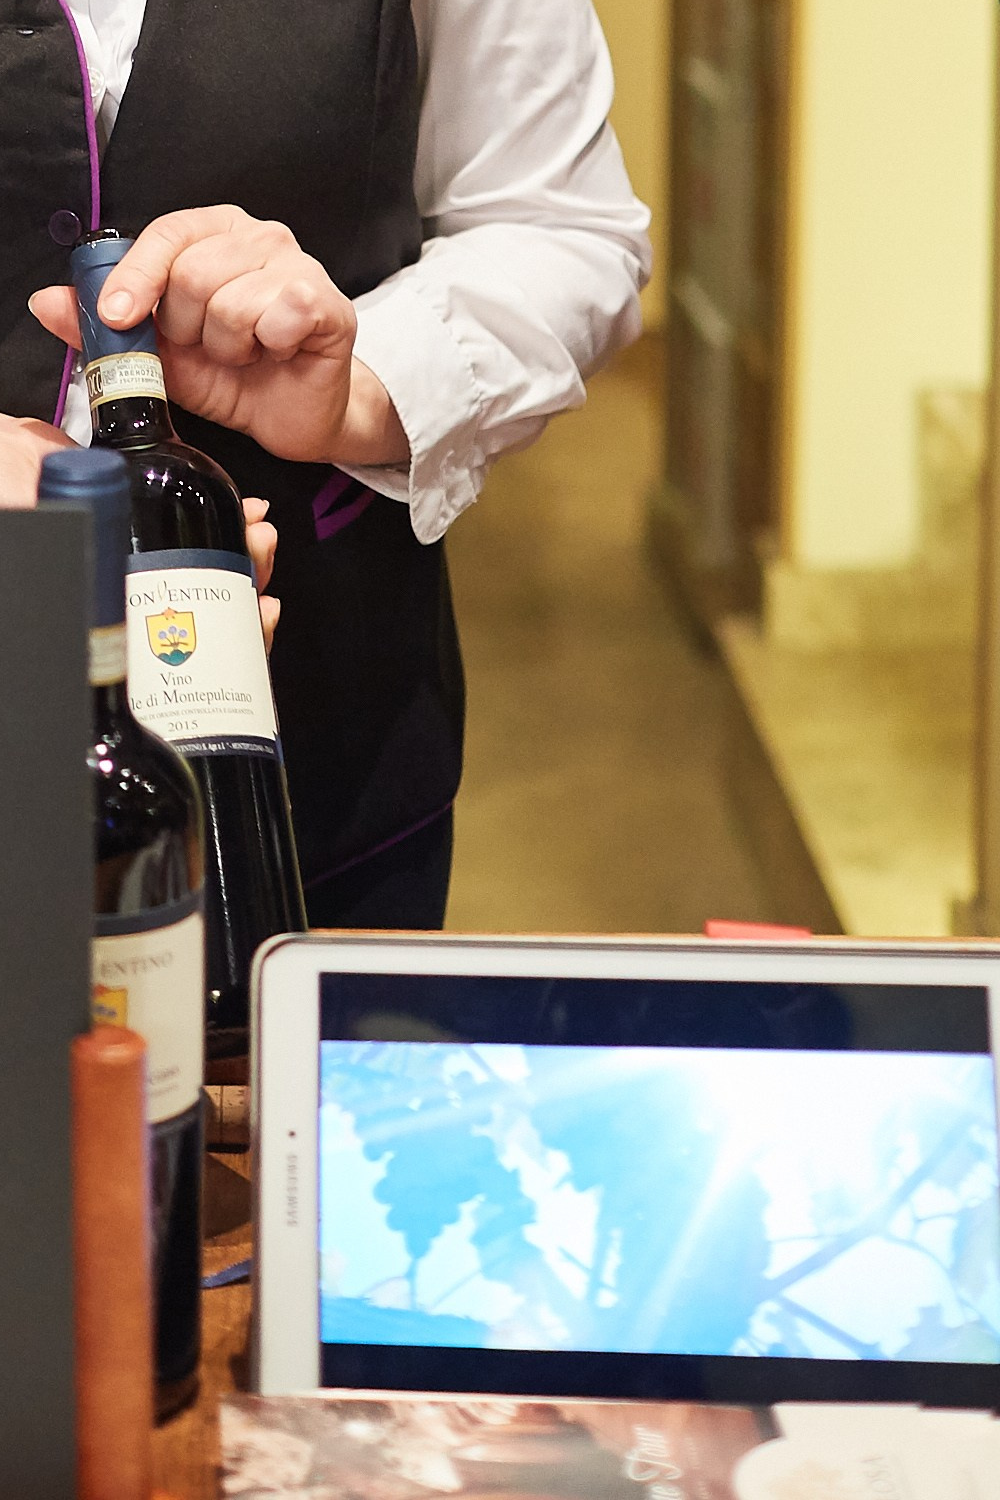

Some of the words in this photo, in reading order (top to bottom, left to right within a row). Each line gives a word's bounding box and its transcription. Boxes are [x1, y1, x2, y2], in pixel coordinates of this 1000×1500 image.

[129, 580, 231, 607] ONVENTINO
[160, 672, 193, 687] Vino
[131, 697, 142, 711] le
[146, 693, 159, 708] di
[163, 688, 253, 705] Montepulciano
[168, 720, 199, 733] 2015
